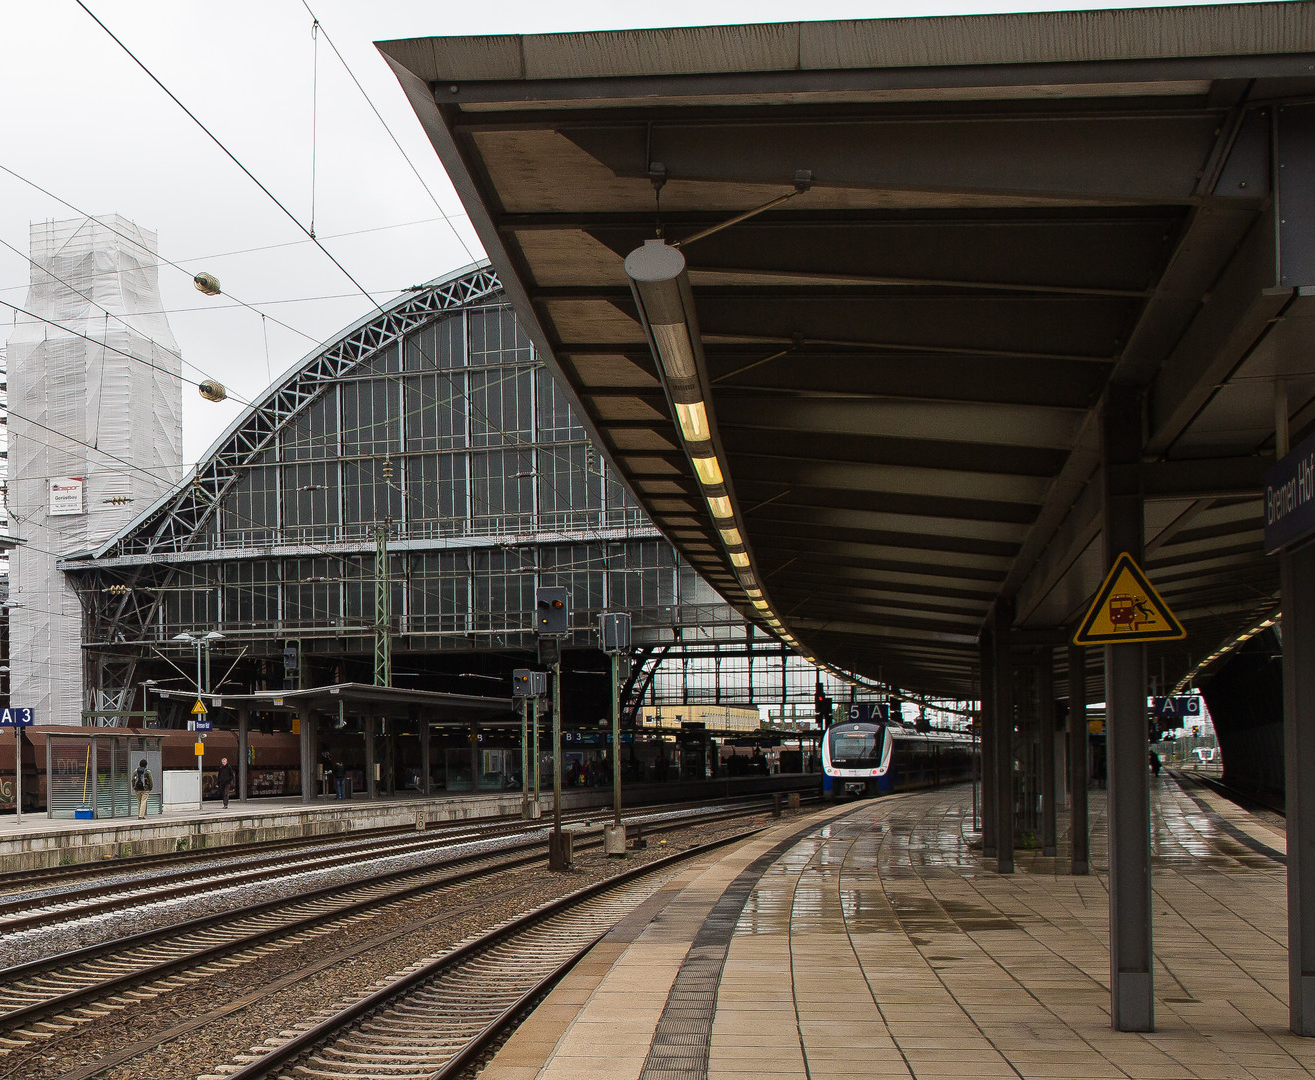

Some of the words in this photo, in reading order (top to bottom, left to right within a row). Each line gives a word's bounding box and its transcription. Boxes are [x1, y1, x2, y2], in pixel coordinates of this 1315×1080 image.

[1267, 477, 1297, 526] Bremen
[1297, 452, 1314, 506] Hbf
[850, 705, 859, 719] 5
[871, 705, 883, 719] A
[1162, 698, 1176, 713] A
[1187, 698, 1198, 712] 6
[1, 708, 12, 723] A
[22, 708, 31, 723] 3
[576, 732, 582, 741] 3
